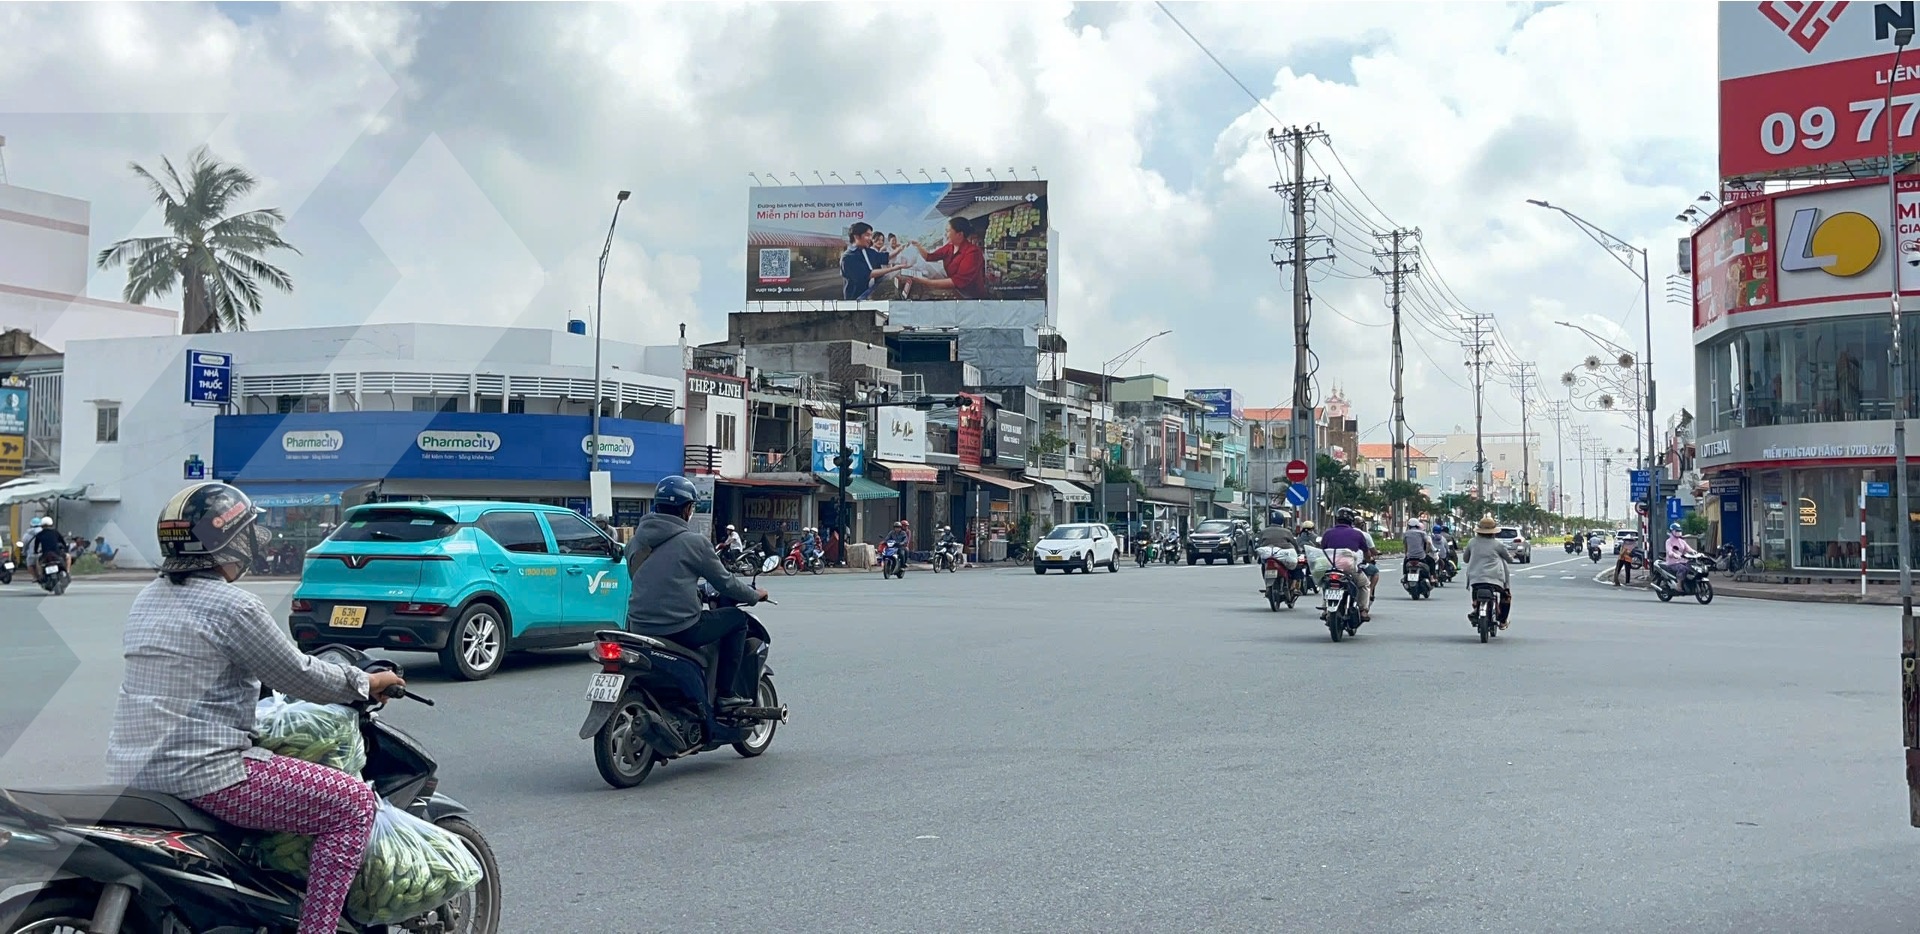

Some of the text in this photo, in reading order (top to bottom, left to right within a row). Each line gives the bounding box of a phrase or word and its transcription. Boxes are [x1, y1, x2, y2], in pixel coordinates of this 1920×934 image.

[1876, 65, 1920, 85] LIÊN
[1760, 106, 1836, 155] 09
[756, 208, 864, 220] Miễn phí loa bán hàng
[203, 368, 219, 377] NHÀ
[198, 379, 223, 389] THUỐC
[688, 377, 742, 398] THÉP LINH
[203, 391, 217, 400] TÂY
[286, 436, 340, 449] Pharmacity
[422, 435, 495, 450] Pharmacity
[1797, 447, 1817, 457] GIAO
[1818, 444, 1842, 457] HÀNG
[1846, 444, 1896, 456] 1900.6778
[341, 608, 357, 616] 63H
[333, 617, 361, 626] 046.25
[595, 676, 619, 687] 62-LD
